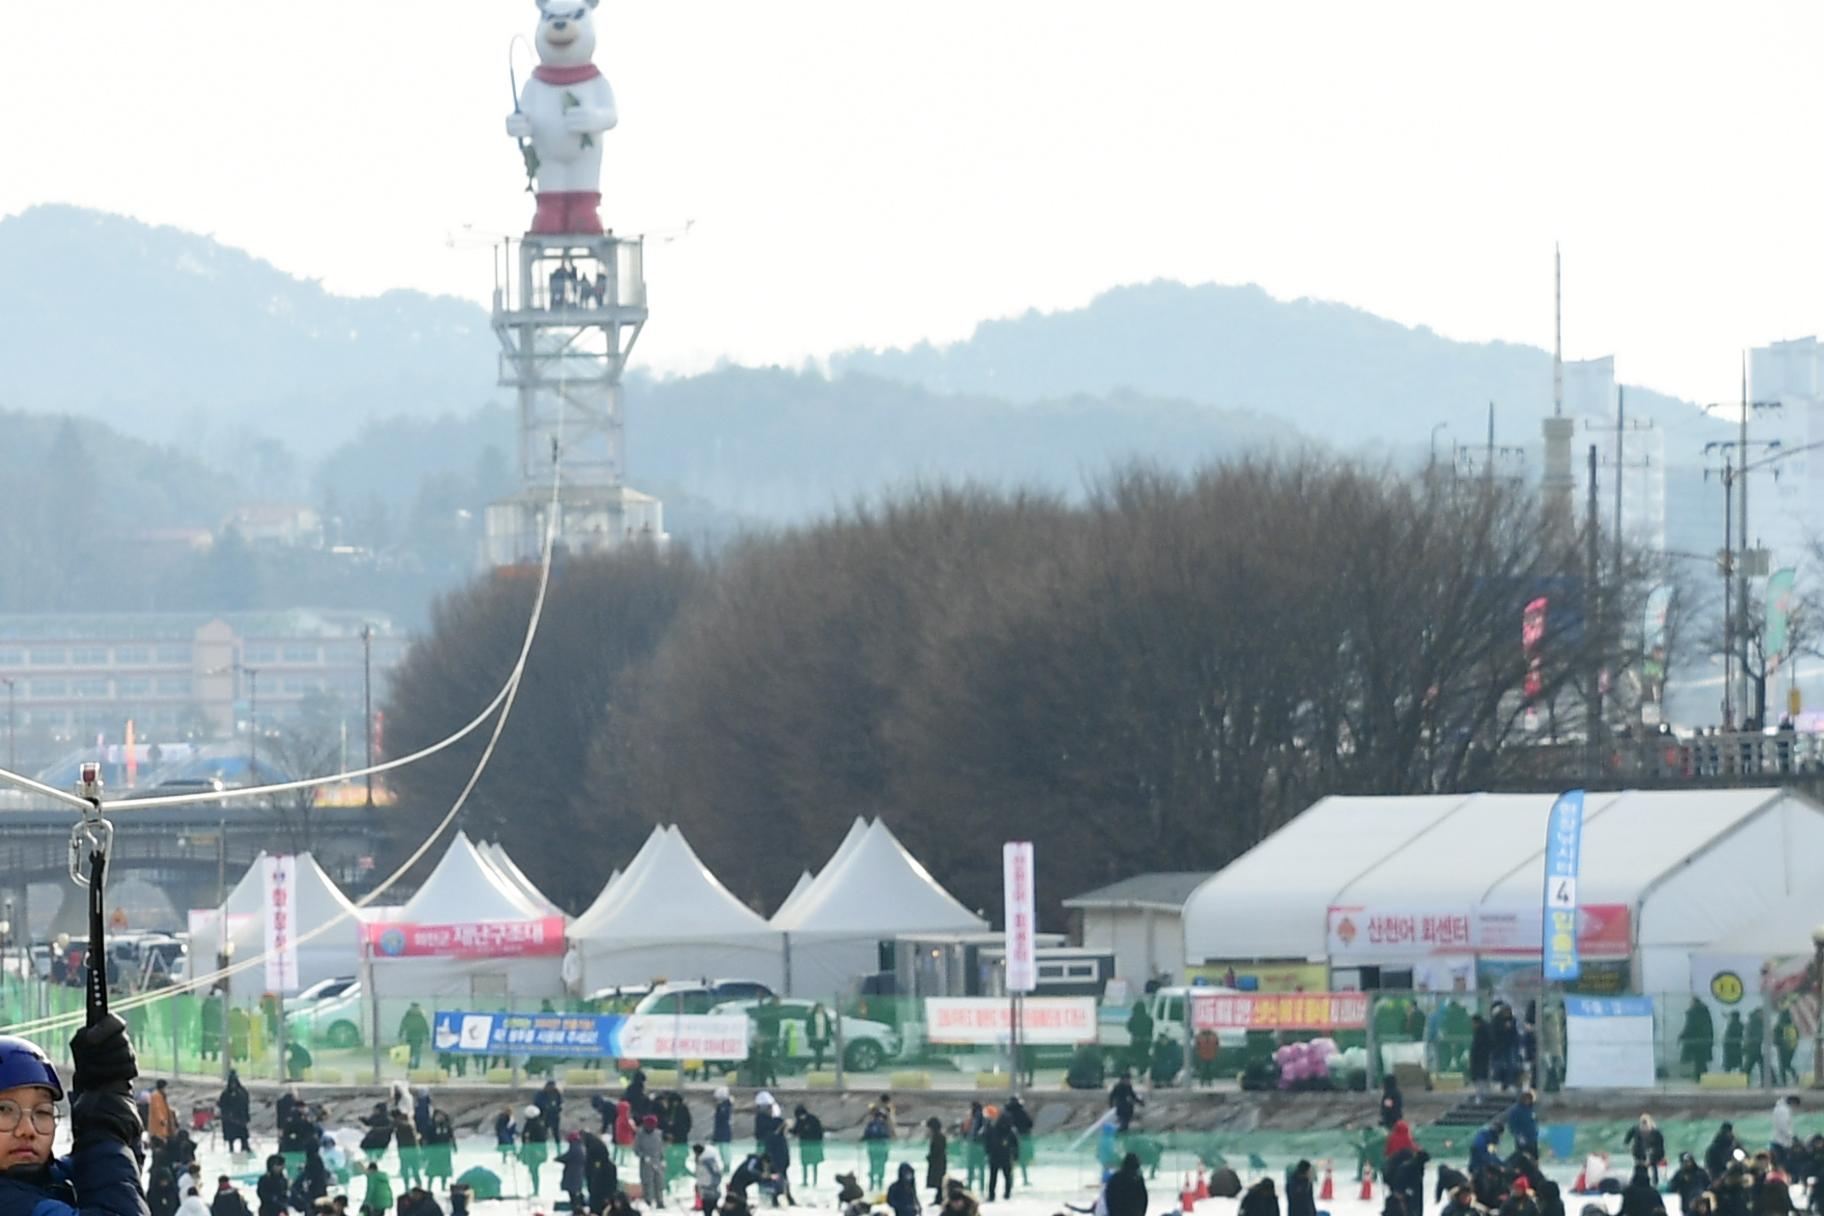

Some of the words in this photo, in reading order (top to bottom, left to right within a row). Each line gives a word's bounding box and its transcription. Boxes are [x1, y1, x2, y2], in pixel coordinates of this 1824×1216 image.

[1556, 880, 1569, 902] 4
[1367, 915, 1416, 944] 산천어
[1421, 914, 1469, 944] 회센터
